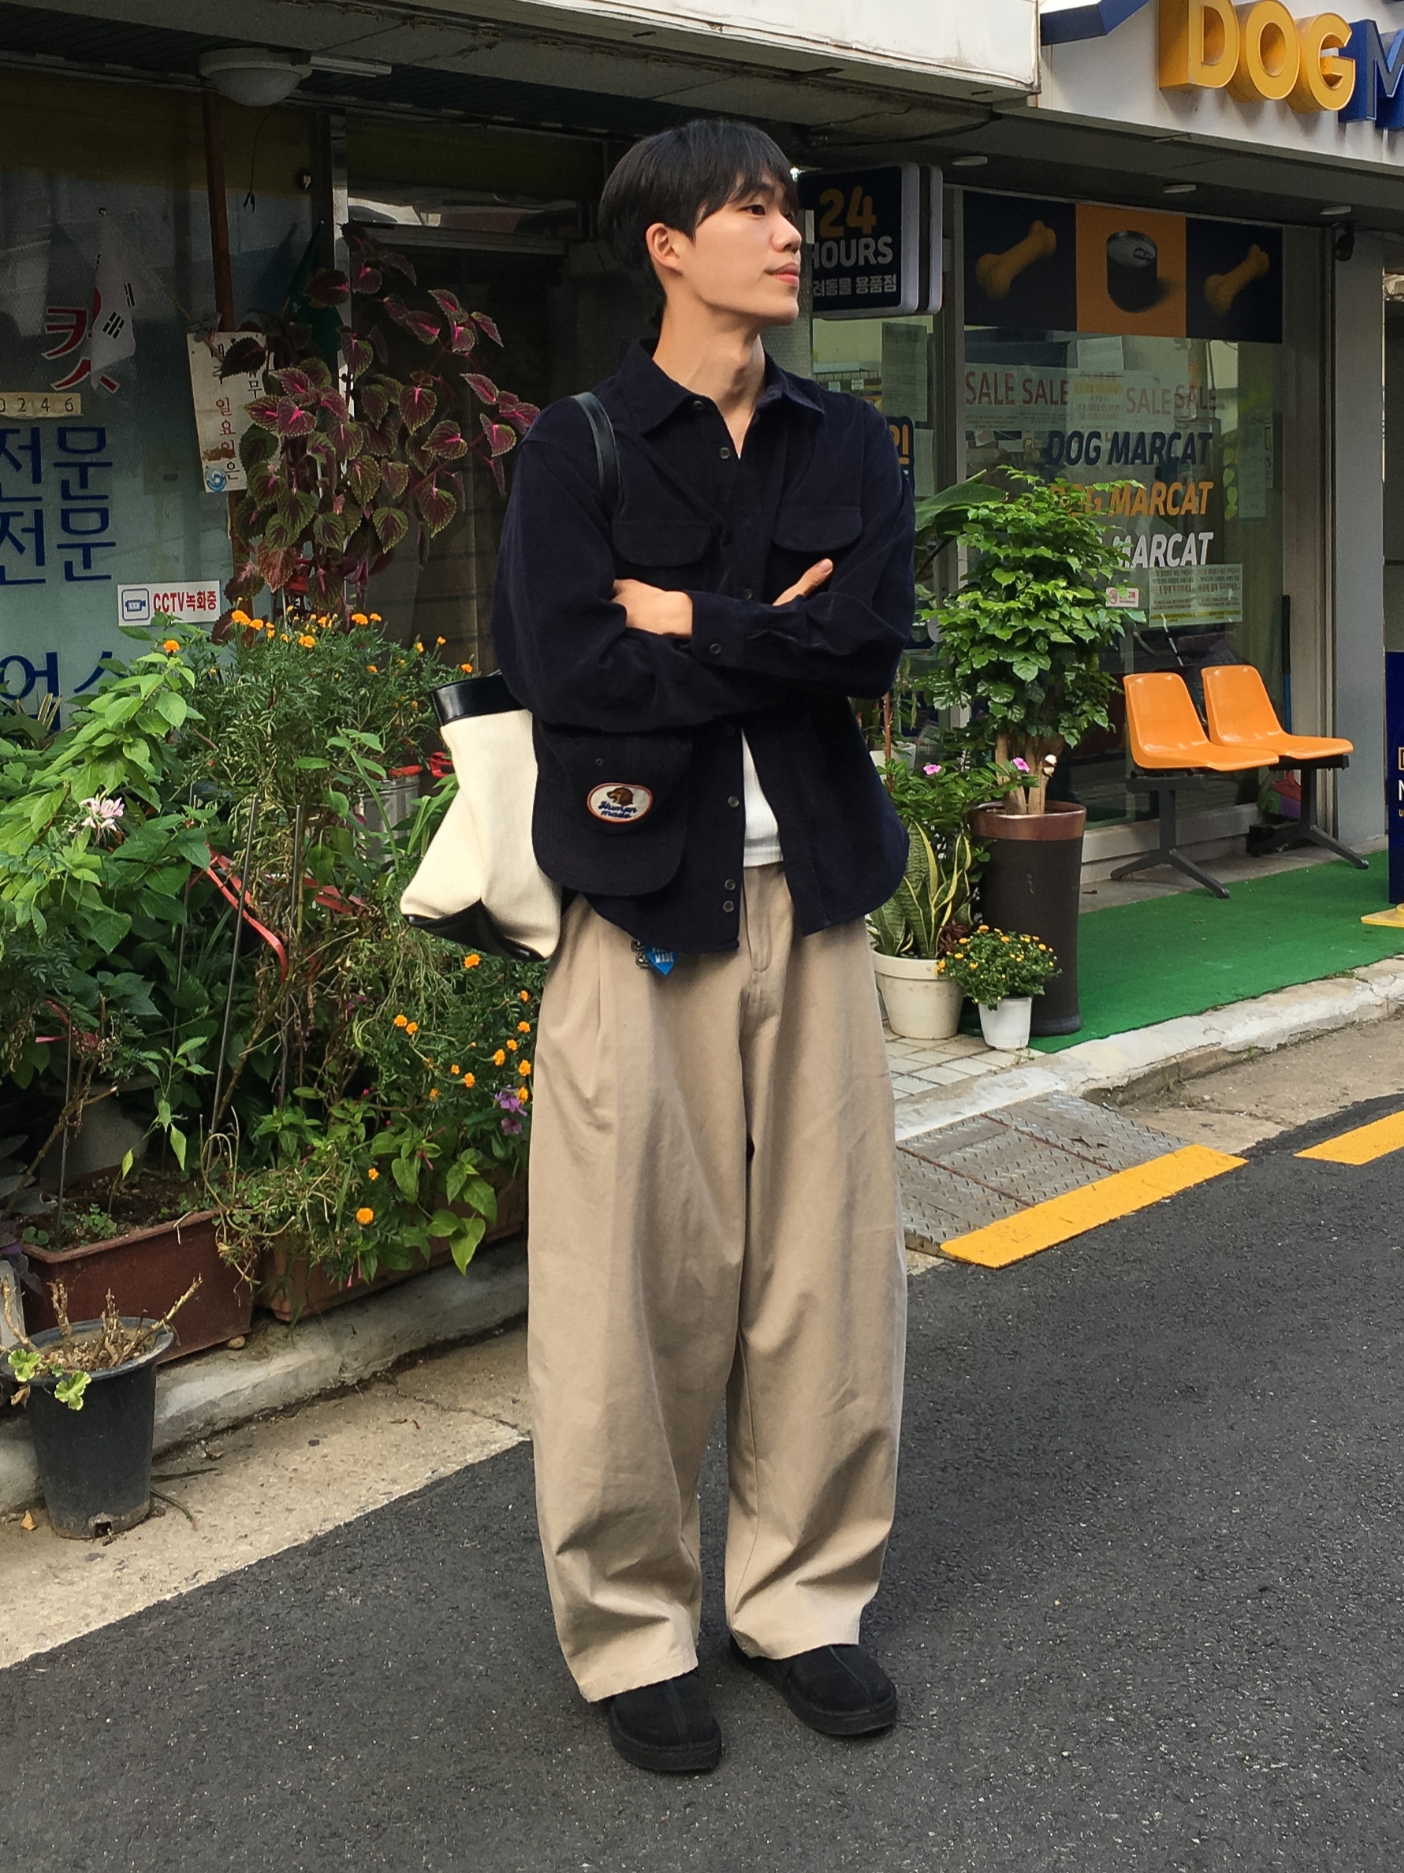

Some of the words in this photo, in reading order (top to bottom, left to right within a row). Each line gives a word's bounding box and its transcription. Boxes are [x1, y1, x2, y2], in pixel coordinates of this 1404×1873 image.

[1159, 0, 1356, 113] DOG
[819, 186, 877, 239] 24
[855, 273, 897, 295] 용품점
[964, 371, 1014, 406] SALE
[1021, 377, 1068, 406] SALE
[1126, 386, 1171, 416] SALE
[1174, 384, 1216, 411] SALE
[0, 426, 113, 500] 전문
[1045, 430, 1101, 466] DOG
[1107, 431, 1213, 466] MARCAT
[1107, 481, 1214, 517] MARCAT
[0, 508, 116, 585] 전문
[1112, 532, 1214, 569] MARCAT
[654, 952, 674, 963] MADE
